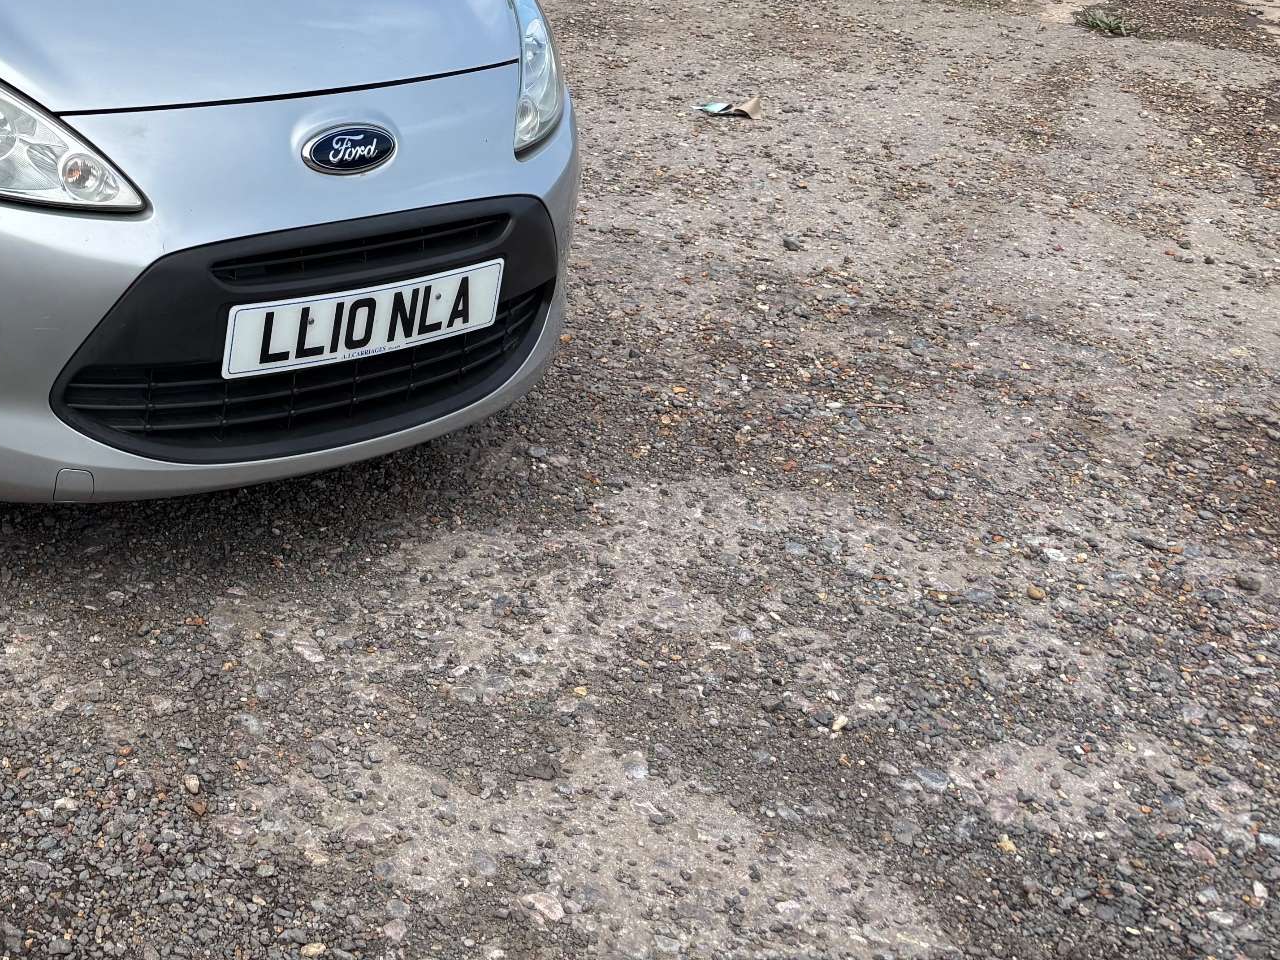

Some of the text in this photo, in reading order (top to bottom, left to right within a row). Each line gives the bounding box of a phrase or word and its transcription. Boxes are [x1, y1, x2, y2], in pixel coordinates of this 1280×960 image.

[328, 134, 378, 163] Ford
[259, 276, 469, 364] LL10 NLA
